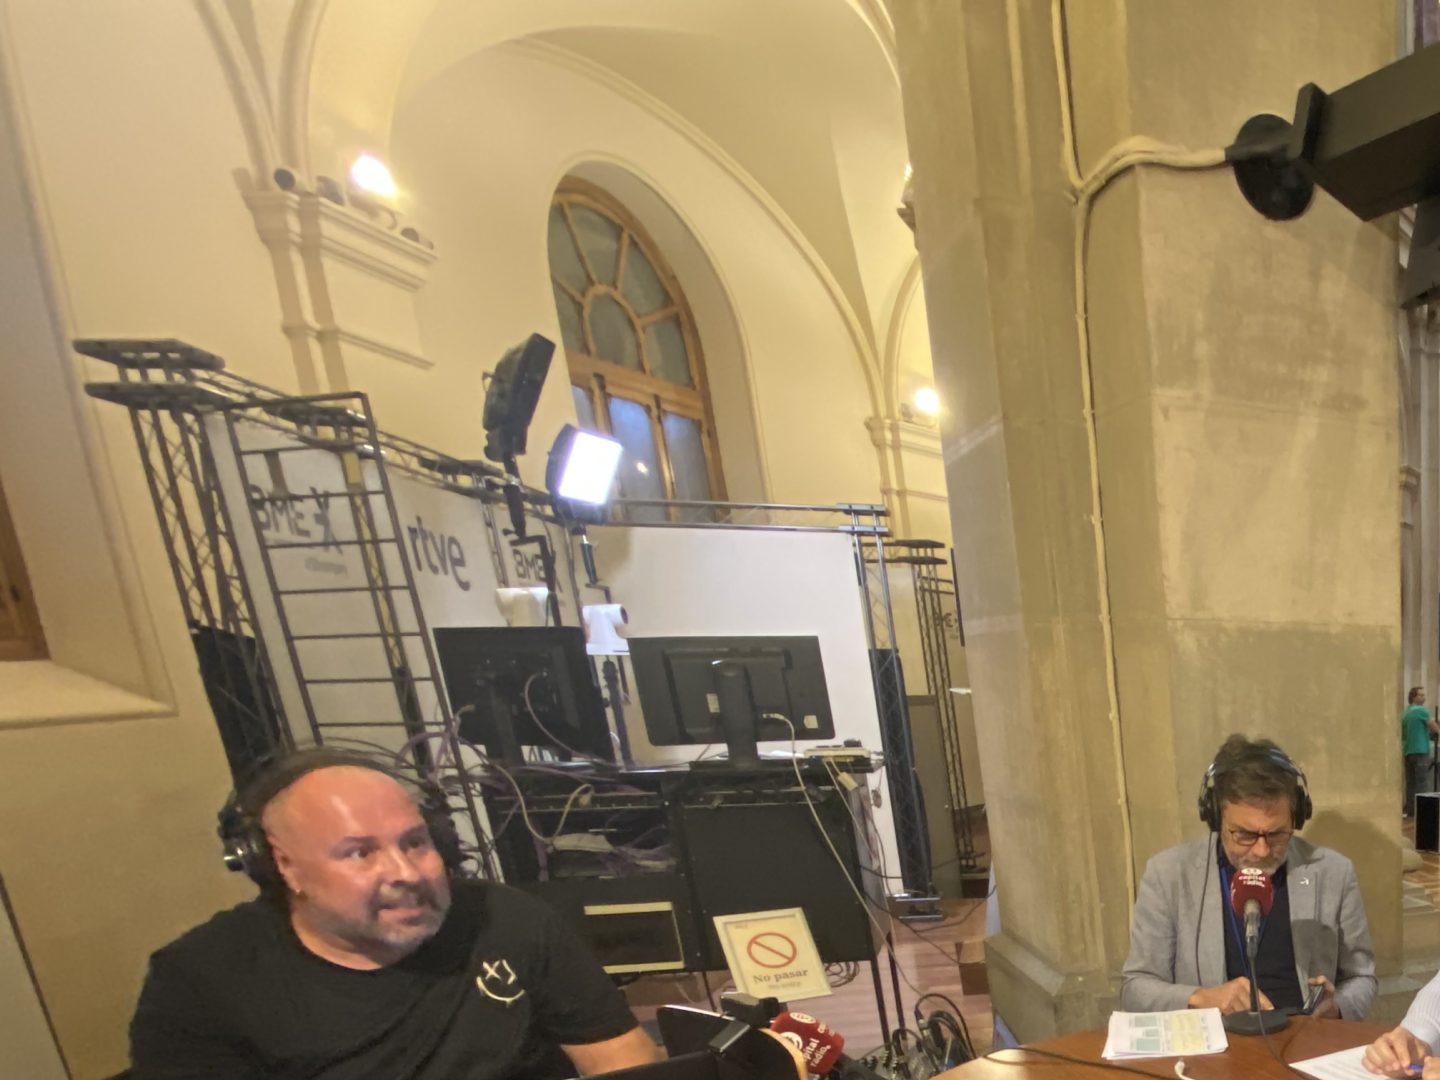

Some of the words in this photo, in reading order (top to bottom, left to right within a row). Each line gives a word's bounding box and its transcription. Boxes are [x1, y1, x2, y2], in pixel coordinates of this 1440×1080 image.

[408, 515, 470, 591] rtve
[753, 974, 771, 983] No
[775, 968, 808, 982] pasar
